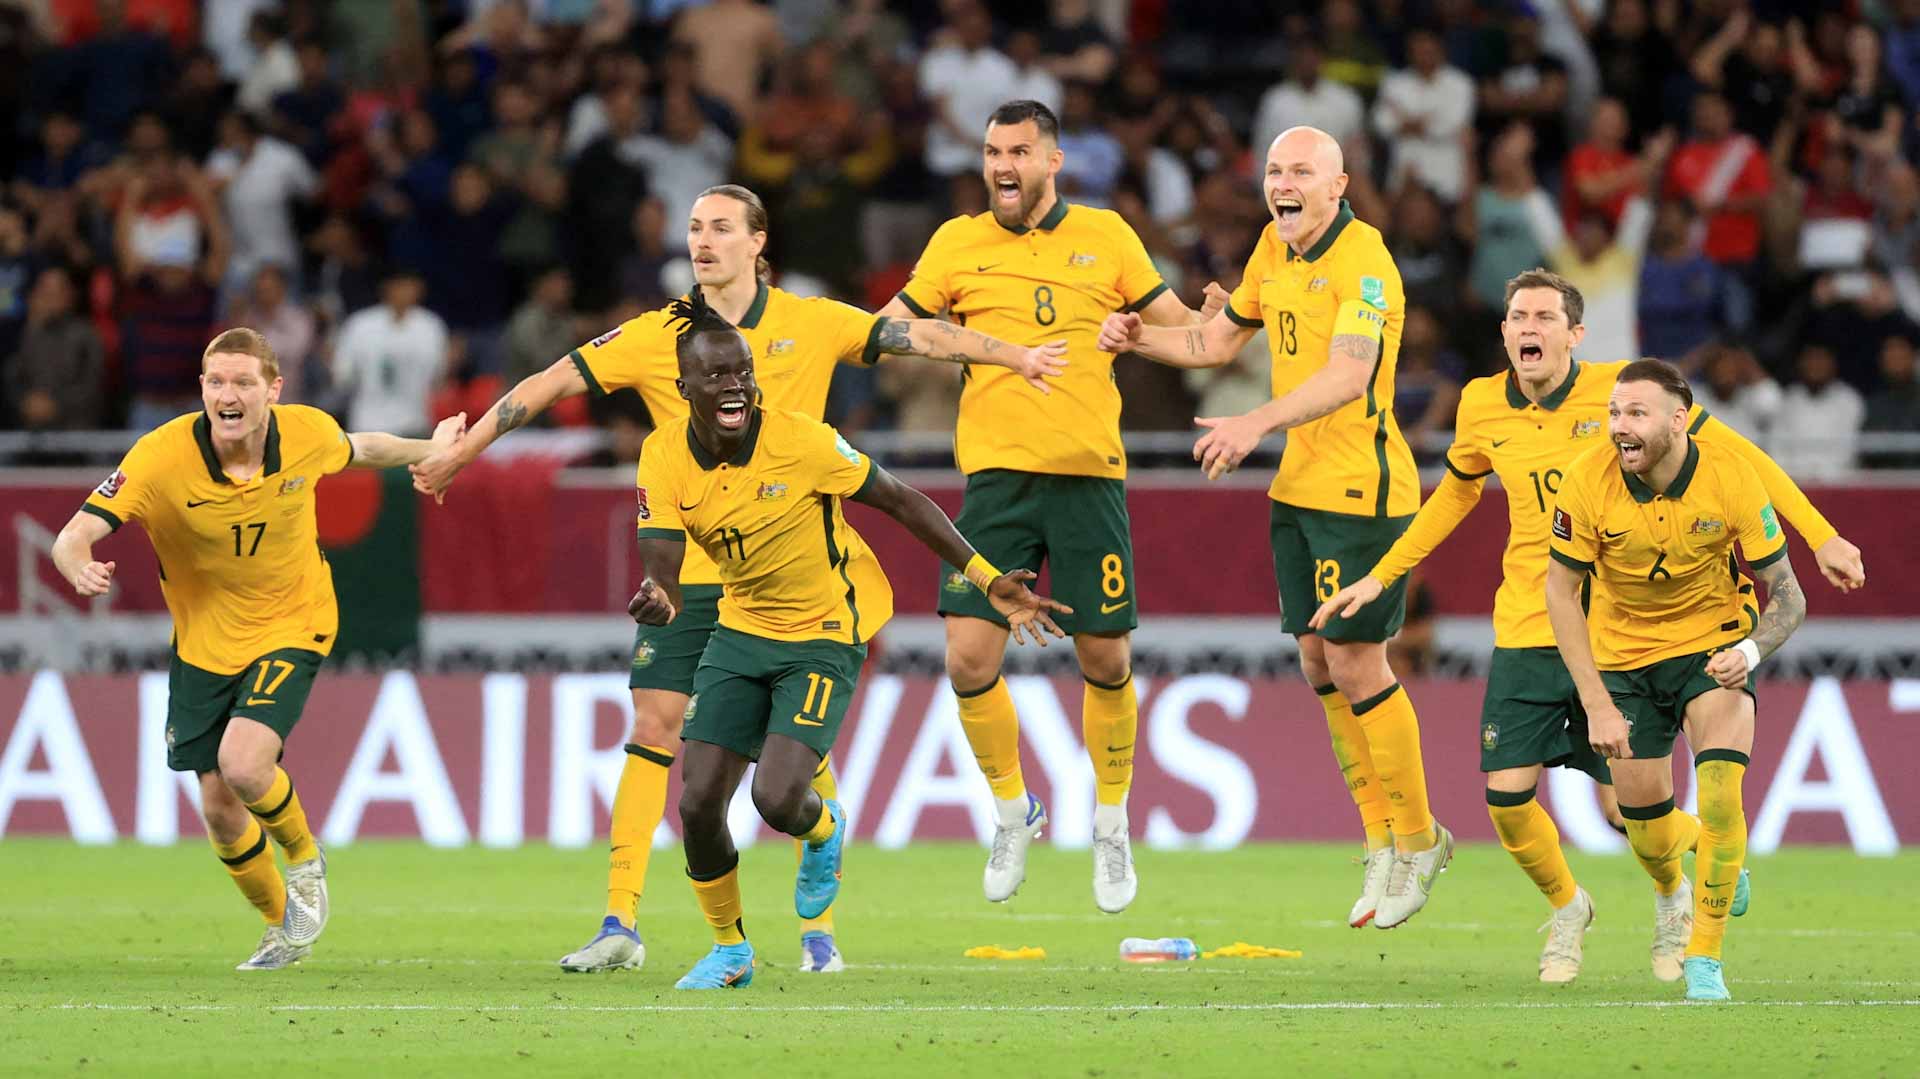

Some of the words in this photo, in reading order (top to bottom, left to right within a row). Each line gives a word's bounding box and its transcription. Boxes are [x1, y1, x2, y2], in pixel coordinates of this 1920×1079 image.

[1034, 285, 1056, 326] 8
[1278, 310, 1297, 356] 13
[1529, 468, 1563, 513] 19
[230, 521, 267, 557] 17
[714, 527, 746, 561] 11
[1101, 552, 1126, 598] 8
[1315, 558, 1341, 603] 13
[1647, 551, 1672, 581] 6
[252, 659, 296, 695] 17
[802, 671, 834, 720] 11
[1701, 896, 1728, 909] AUS
